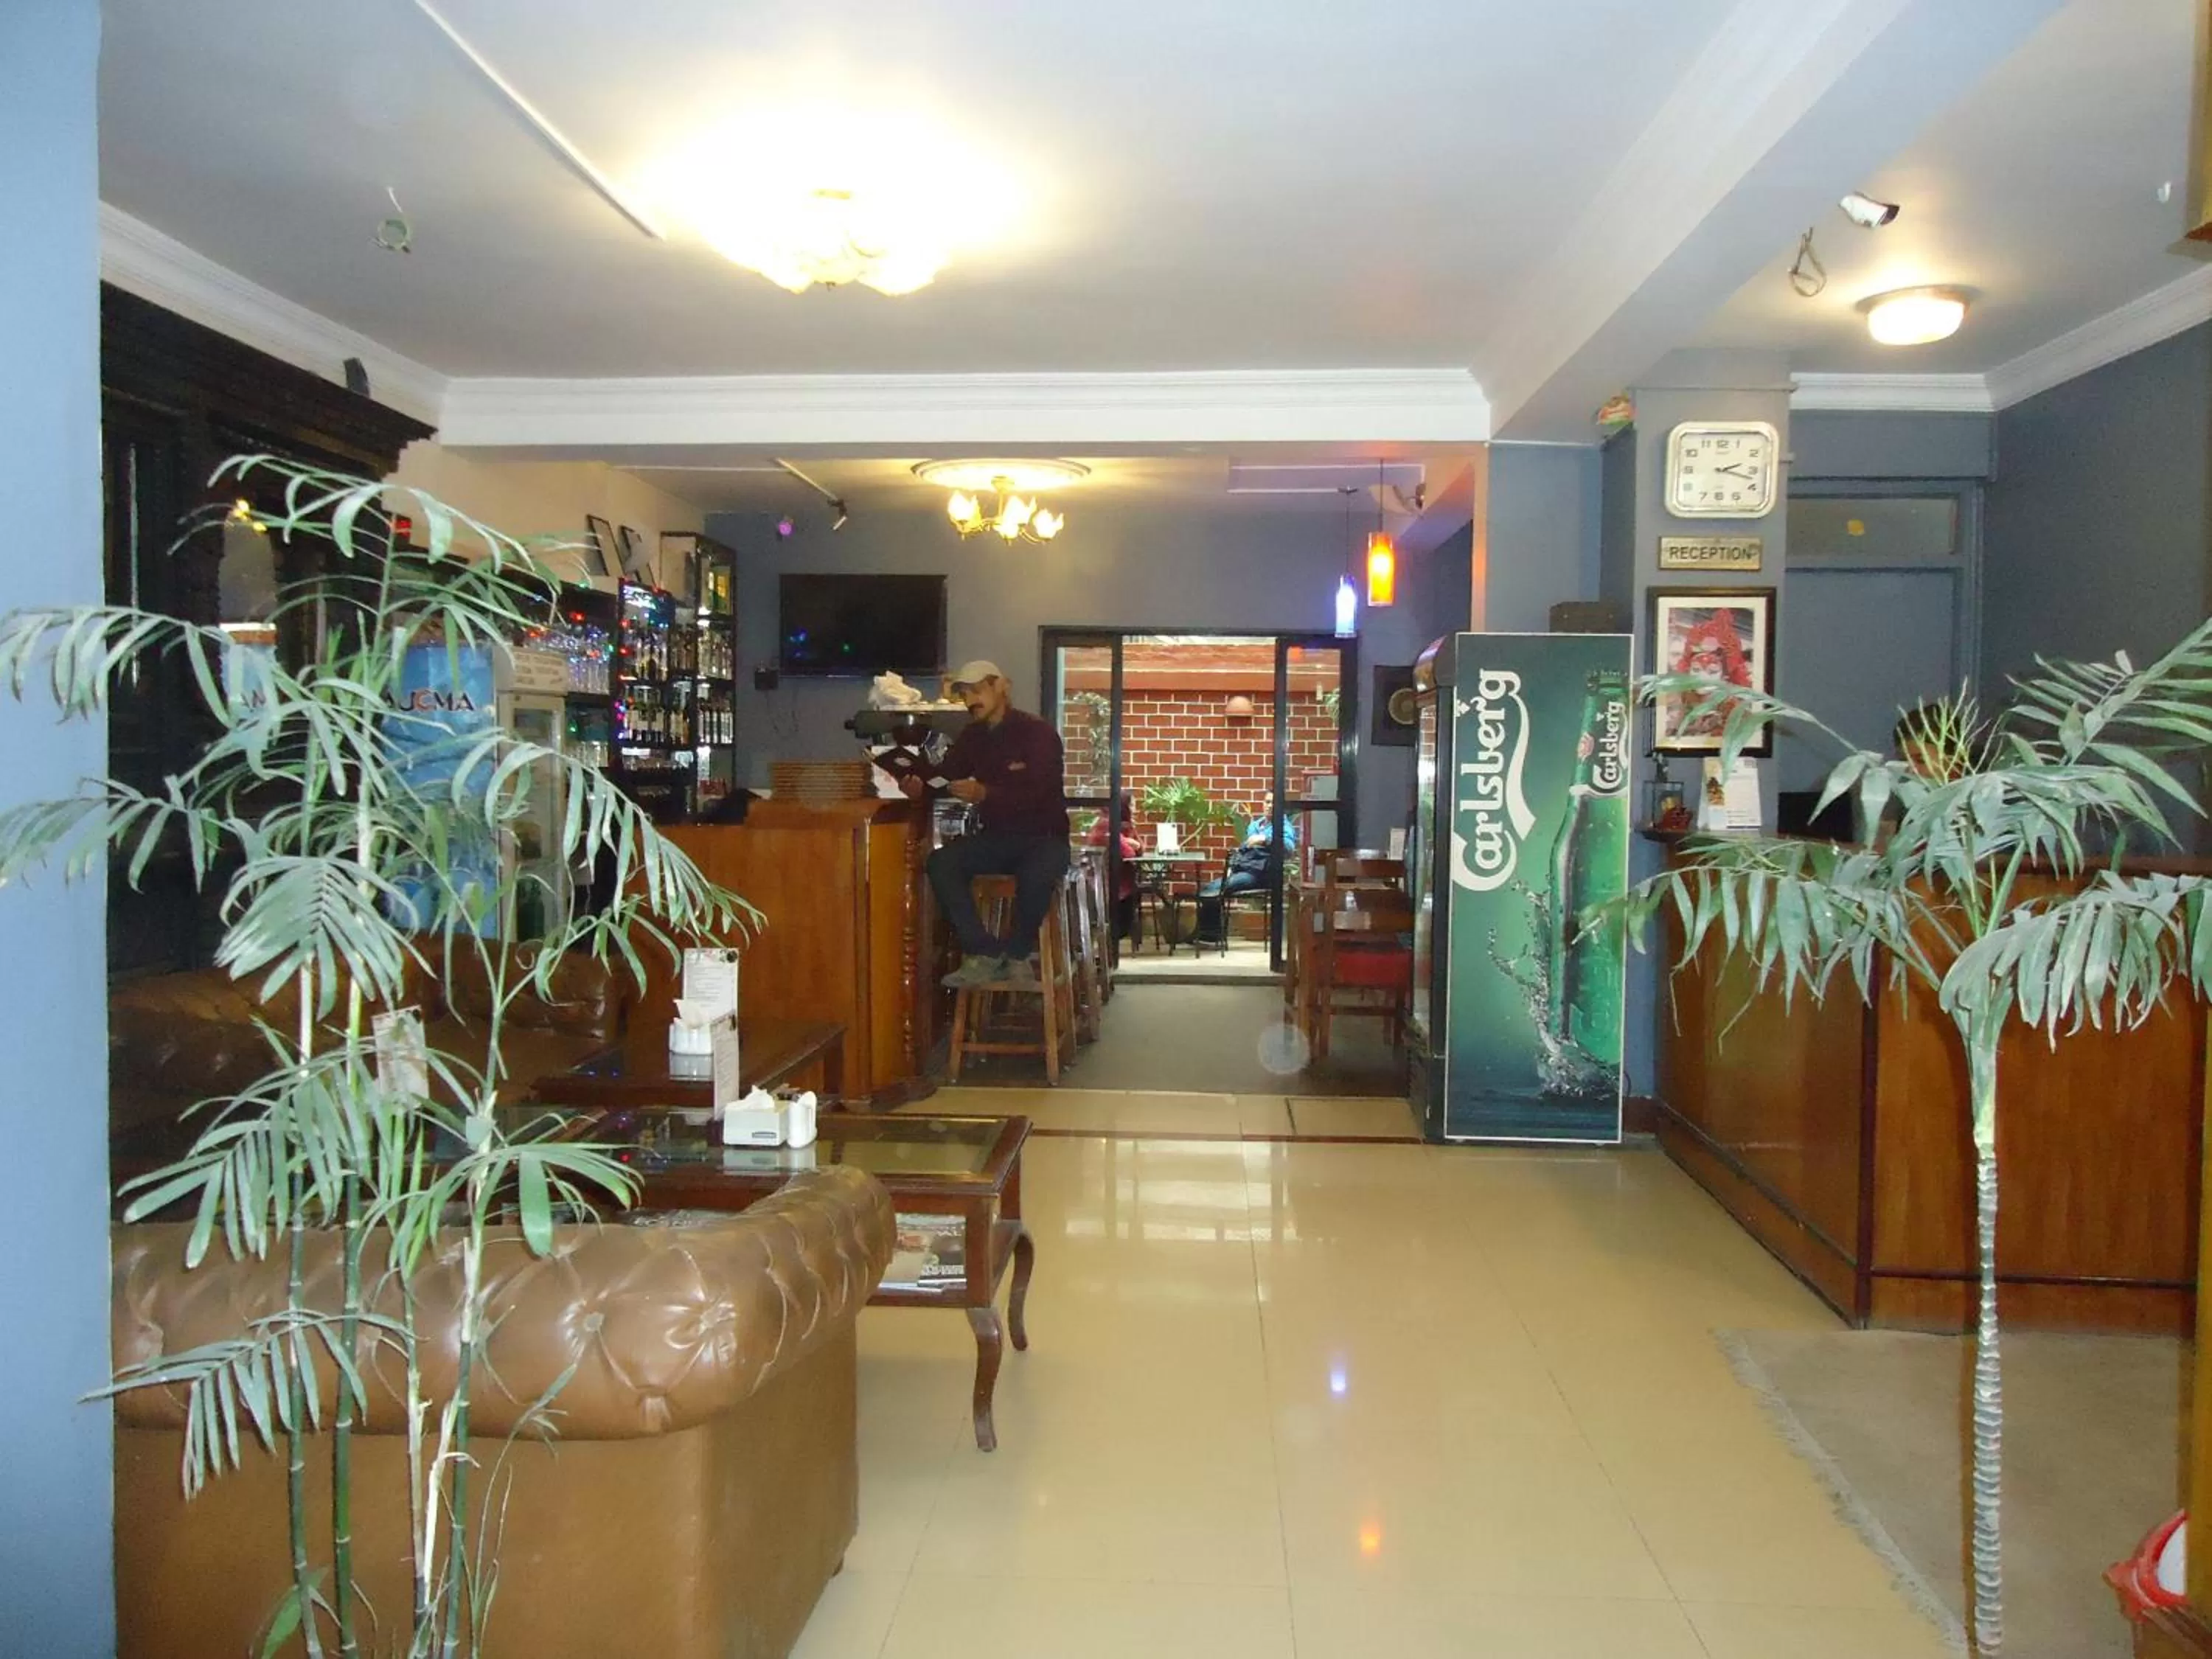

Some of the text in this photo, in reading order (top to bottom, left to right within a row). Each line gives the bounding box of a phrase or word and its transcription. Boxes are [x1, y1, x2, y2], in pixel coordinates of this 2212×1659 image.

[1701, 439, 1711, 448] 11
[1717, 439, 1729, 448] 12
[1686, 448, 1698, 457] 10
[1749, 449, 1759, 458] 2
[1748, 466, 1758, 475] 3
[1747, 483, 1757, 492] 4
[1699, 492, 1708, 501] 7
[1669, 546, 1753, 560] RECEPTION
[1592, 700, 1629, 790] Carlsberg
[1451, 668, 1537, 891] Carlsberg
